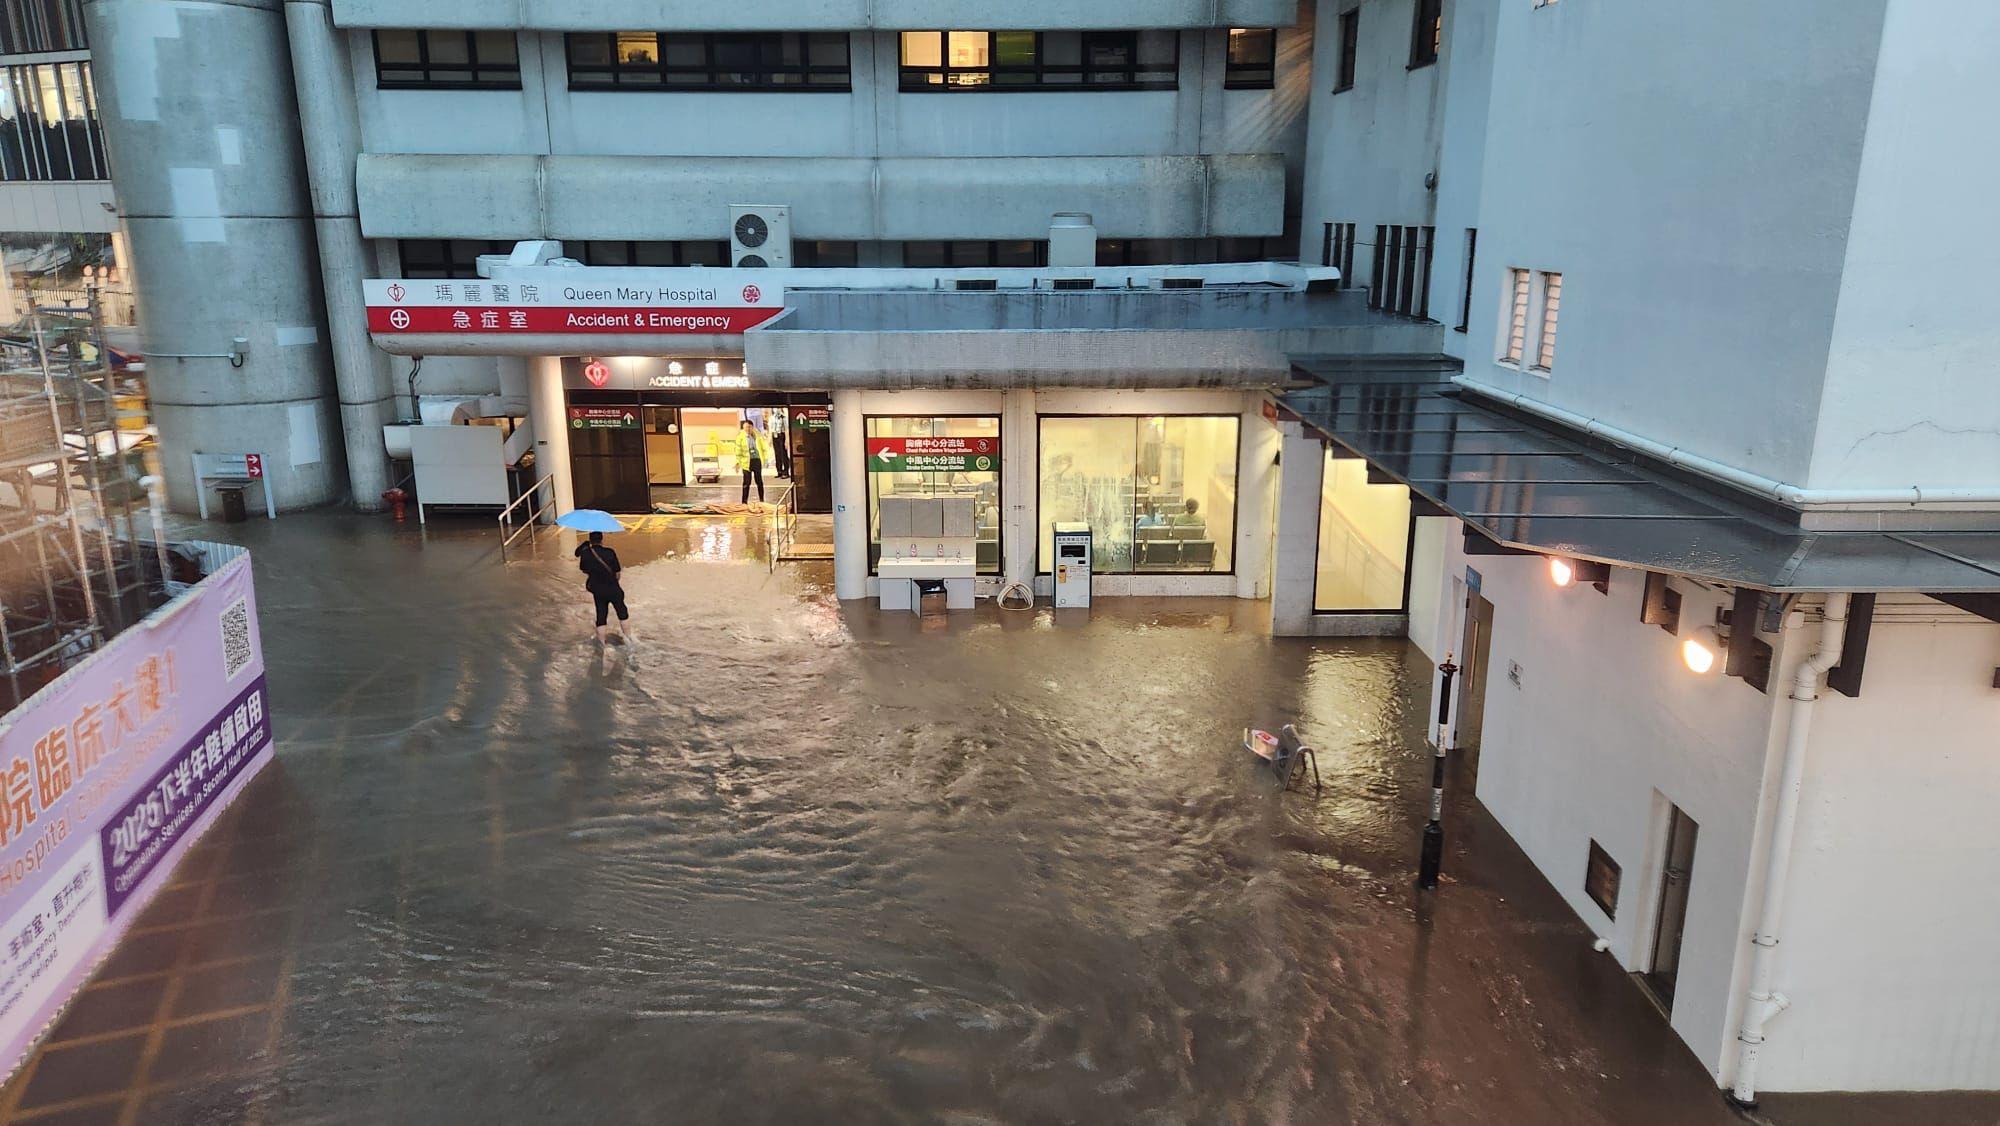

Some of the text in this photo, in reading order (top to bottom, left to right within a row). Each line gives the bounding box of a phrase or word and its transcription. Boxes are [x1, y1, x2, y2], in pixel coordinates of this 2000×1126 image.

[435, 284, 539, 302] 瑪麗醫院
[564, 287, 717, 303] Queen Mary Hospital
[452, 310, 528, 328] 急症室
[567, 313, 731, 329] Accident & Emergency
[668, 361, 747, 376] 急症
[649, 376, 702, 388] ACCIDENT
[702, 377, 710, 388] &
[905, 456, 965, 465] 中風中心分流站
[161, 802, 195, 841] Services
[194, 792, 202, 807] in
[202, 764, 228, 797] Second
[228, 749, 242, 771] Half
[241, 741, 249, 758] of
